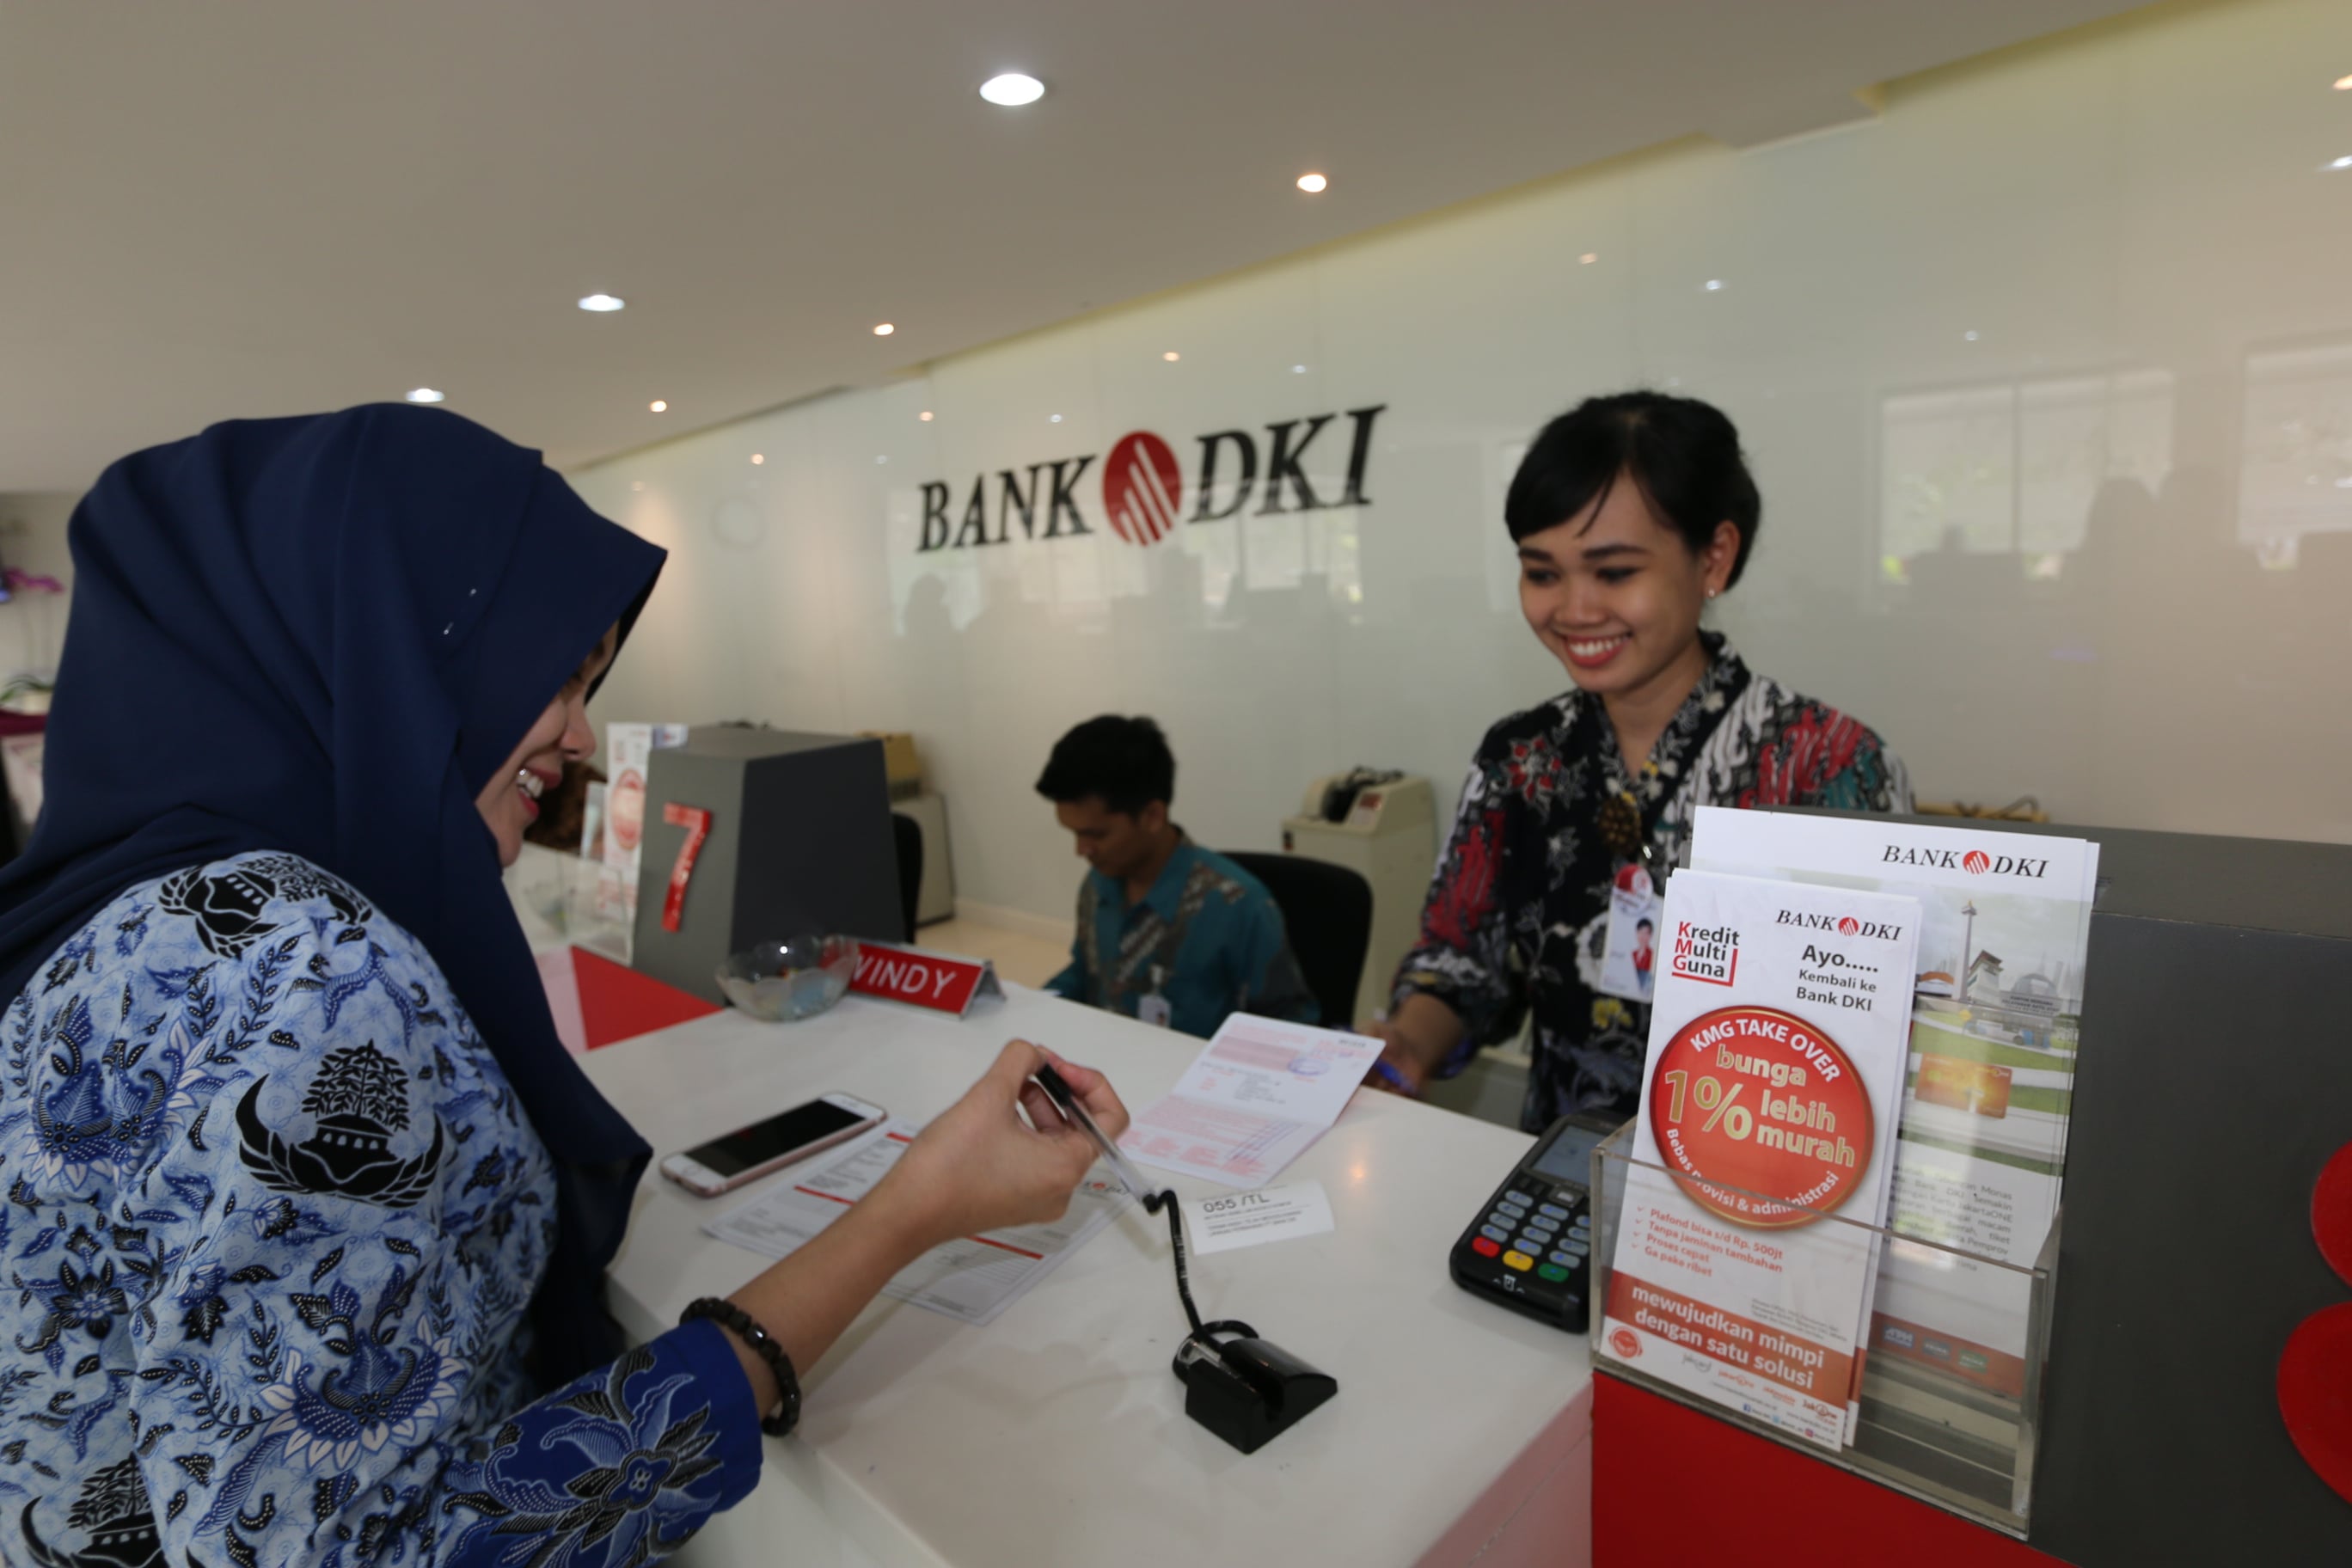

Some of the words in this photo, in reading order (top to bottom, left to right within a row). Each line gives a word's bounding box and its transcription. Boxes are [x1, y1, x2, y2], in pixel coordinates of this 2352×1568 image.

[916, 453, 1099, 553] BANK
[1187, 404, 1387, 524] DKI
[660, 801, 712, 933] 7
[1883, 845, 1960, 869] BANK
[1992, 855, 2049, 878] DKI
[1677, 921, 1740, 946] Kredit
[1775, 910, 1837, 931] BANK
[1860, 922, 1903, 941] DKI
[1672, 955, 1725, 977] Guna
[1675, 938, 1727, 961] Multi
[1796, 987, 1838, 1006] Bank
[1842, 995, 1872, 1012] DKI
[1798, 970, 1857, 989] Kembali
[1860, 979, 1877, 993] ke
[1690, 1020, 1736, 1052] KMG
[1736, 1019, 1789, 1043] TAKE
[1790, 1033, 1841, 1083] OVER
[1716, 1044, 1807, 1087] bunga
[1664, 1069, 1753, 1141] 1%
[1760, 1089, 1836, 1133] lebih
[1756, 1124, 1855, 1167] murah
[1667, 1128, 1694, 1172] Bebas
[1691, 1171, 1735, 1208] ovisi
[1736, 1197, 1749, 1211] &
[1646, 1233, 1679, 1253] Proses
[1680, 1246, 1710, 1265] cepat
[1648, 1221, 1679, 1240] Tanpa
[1680, 1232, 1724, 1254] jaminan
[1724, 1246, 1783, 1273] tambahan
[1650, 1208, 1689, 1234] Plafond
[1691, 1222, 1713, 1239] bisa
[1753, 1242, 1784, 1260] 500jt
[1631, 1284, 1755, 1343] mewujudkan
[1759, 1331, 1825, 1370] mimpi
[1634, 1308, 1703, 1348] dengan
[1706, 1334, 1749, 1364] satu
[1753, 1353, 1815, 1390] solusi
